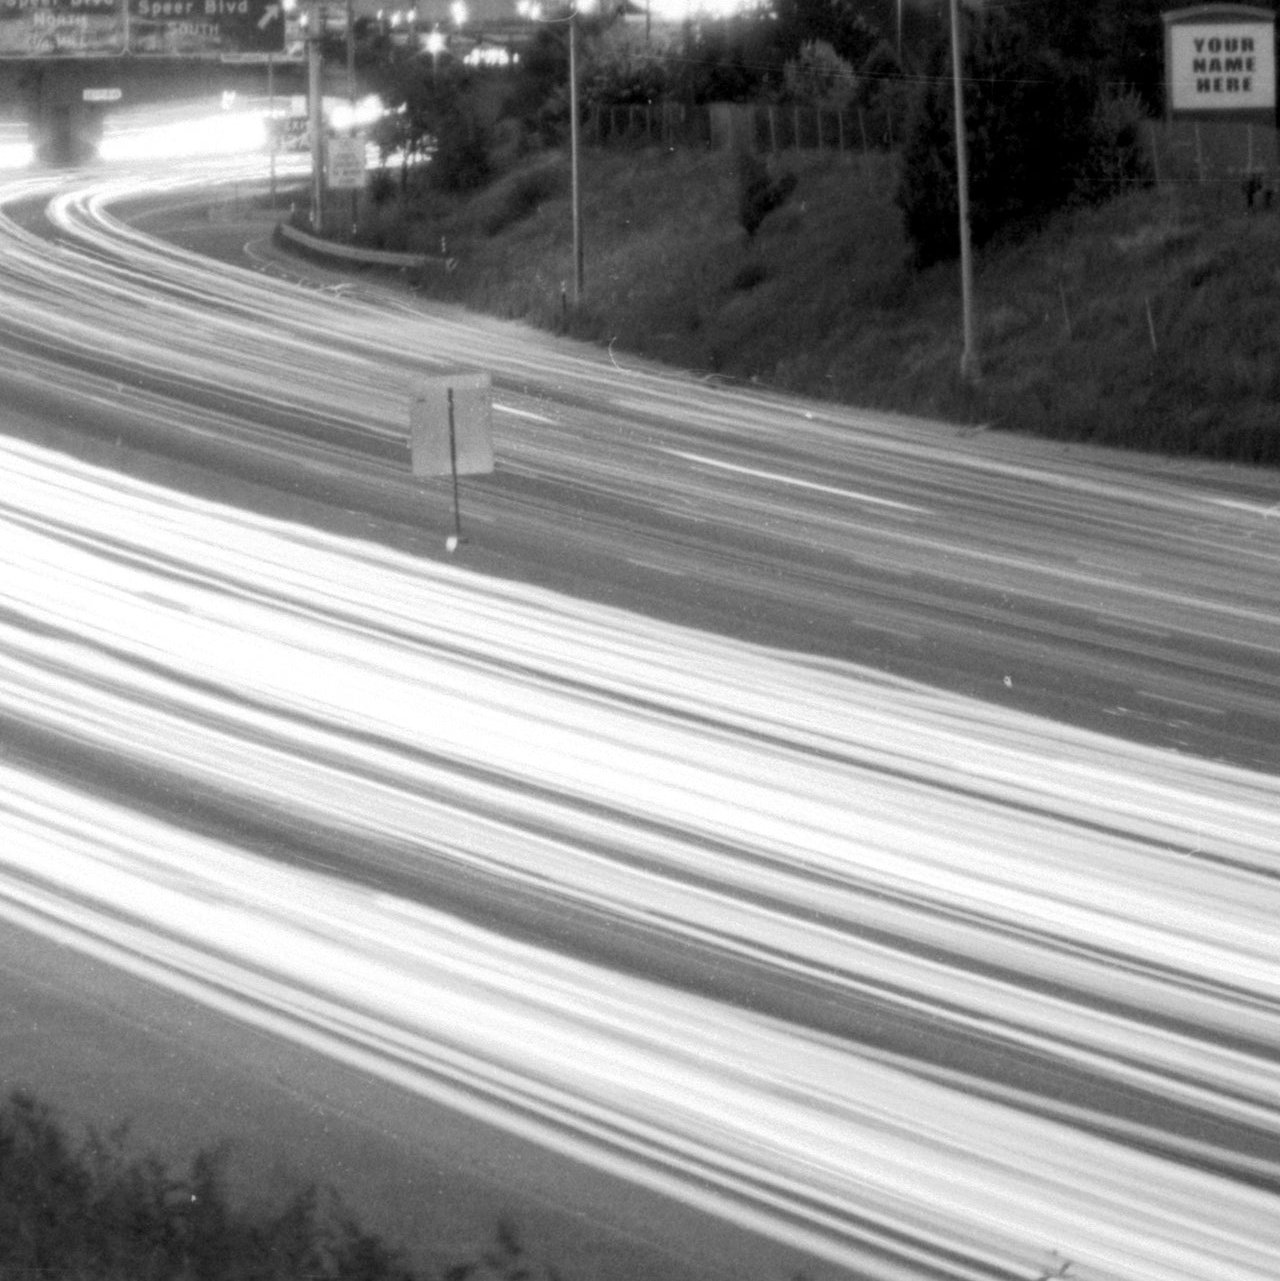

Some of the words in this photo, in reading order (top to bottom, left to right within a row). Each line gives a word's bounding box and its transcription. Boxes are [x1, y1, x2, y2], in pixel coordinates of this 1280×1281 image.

[1193, 37, 1255, 54] YOUR
[1192, 57, 1256, 73] NAME
[1196, 77, 1253, 93] HERE
